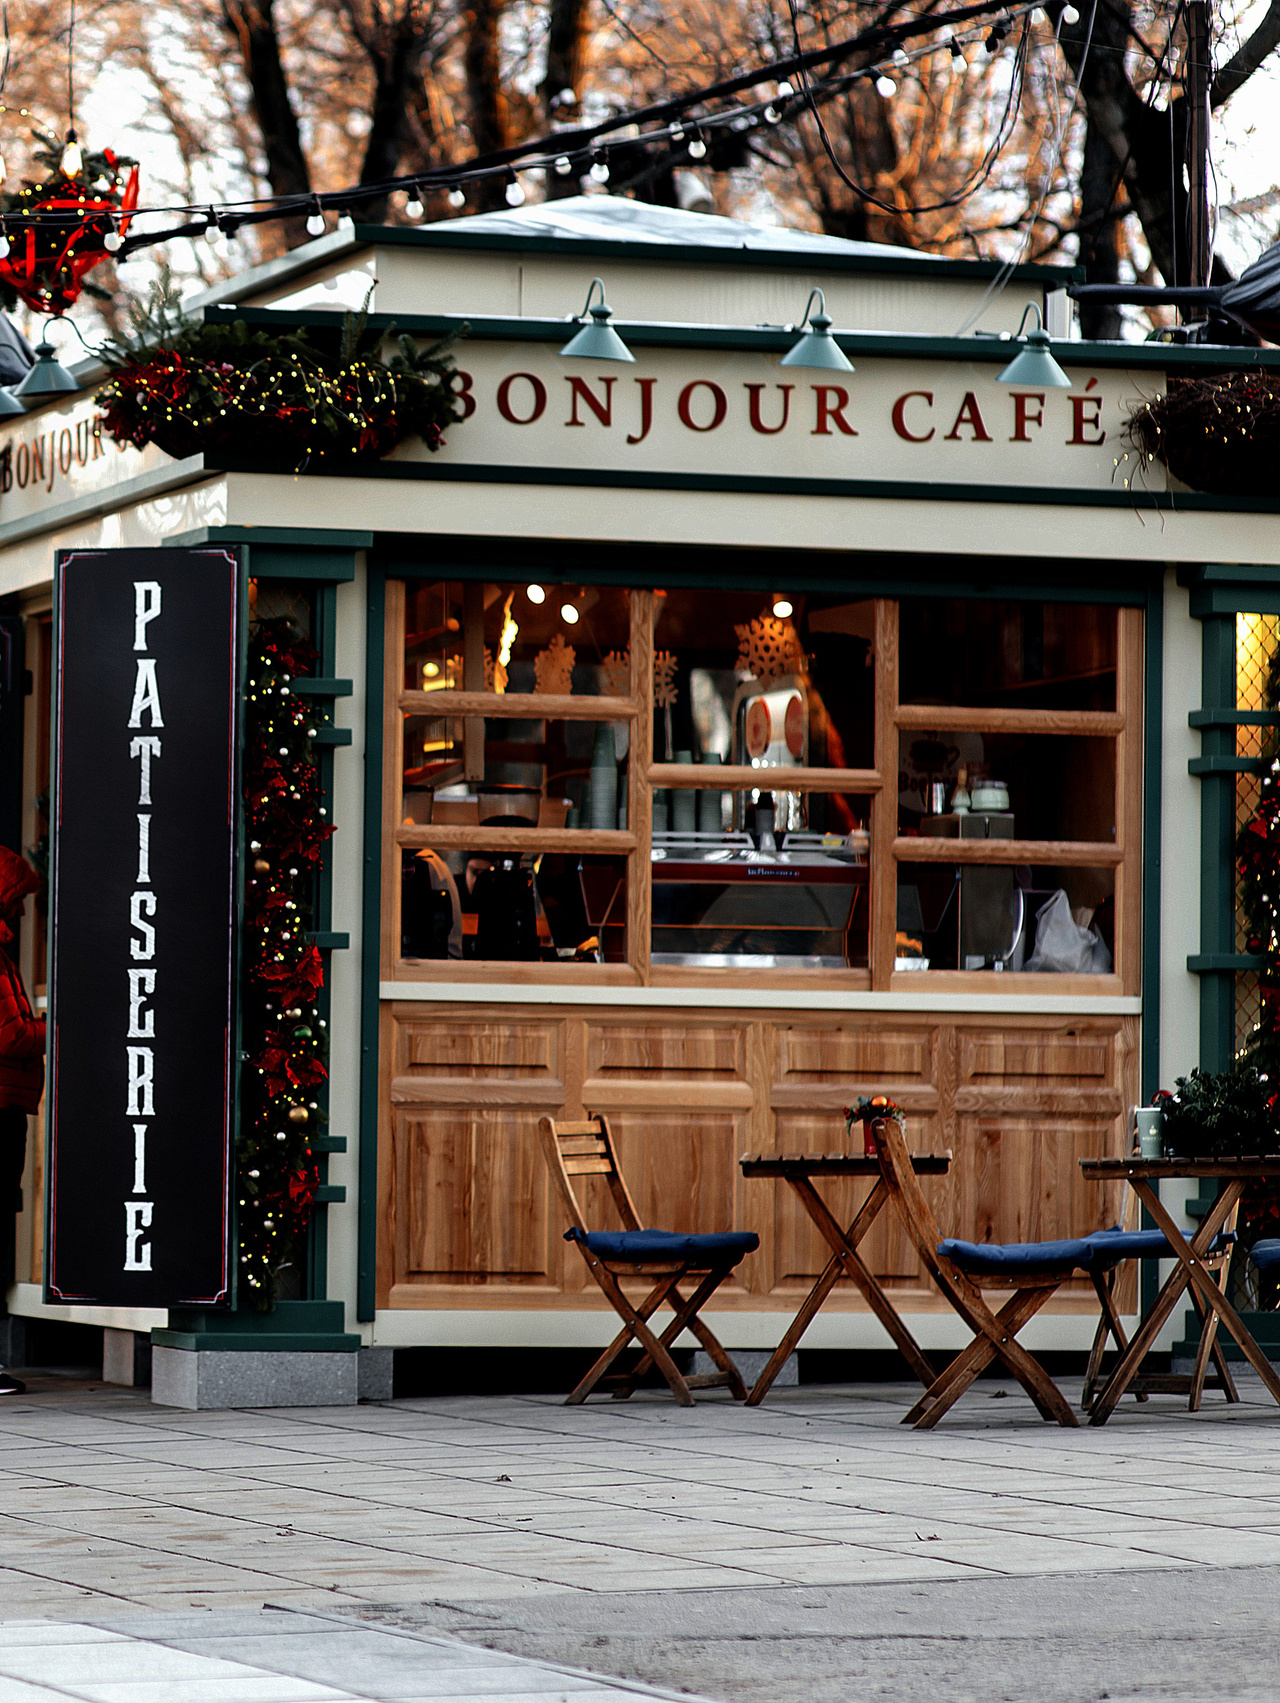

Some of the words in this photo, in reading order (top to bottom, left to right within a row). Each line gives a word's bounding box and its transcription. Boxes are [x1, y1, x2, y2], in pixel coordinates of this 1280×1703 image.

[442, 371, 859, 445] BONJOUR
[891, 376, 1107, 447] CAFÉ
[0, 413, 106, 494] BONJOUR
[122, 580, 165, 1273] PATISERIE
